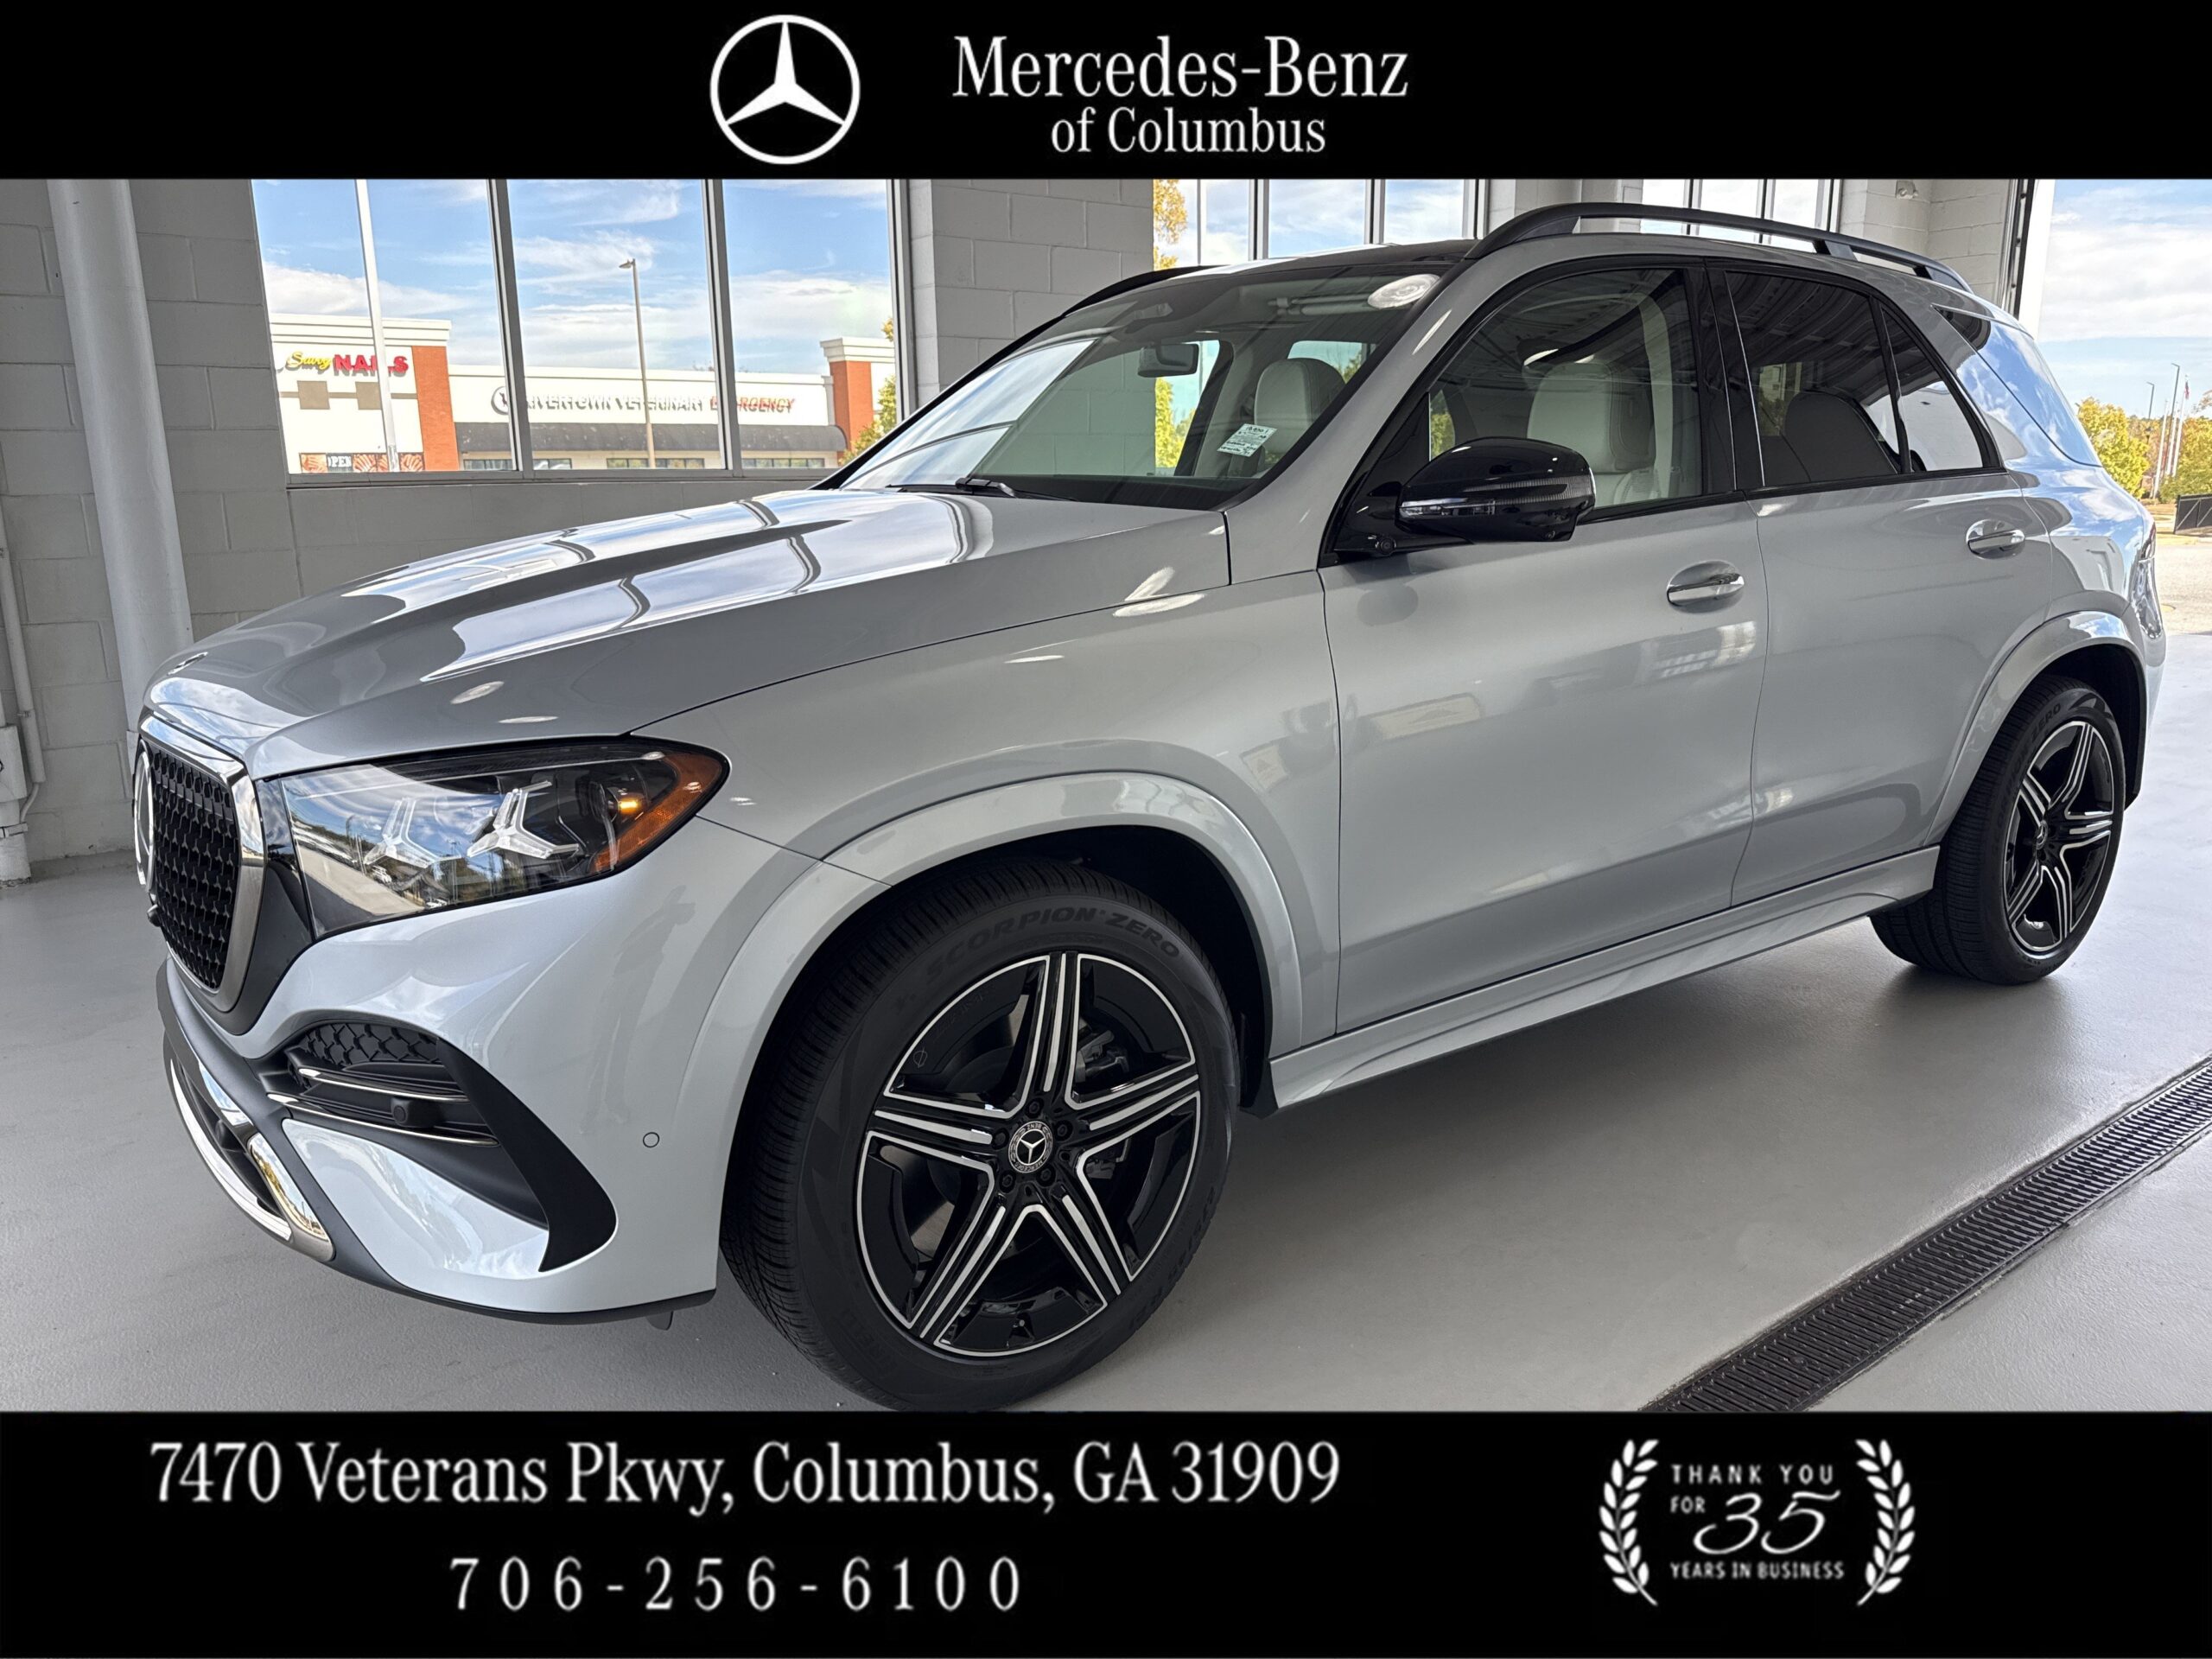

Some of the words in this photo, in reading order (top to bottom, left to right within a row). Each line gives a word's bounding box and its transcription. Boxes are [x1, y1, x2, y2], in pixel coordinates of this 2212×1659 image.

[333, 354, 409, 375] NAIS
[709, 396, 795, 412] ERGENCY
[926, 907, 1096, 978] SCORPION
[1105, 911, 1180, 958] ZERO
